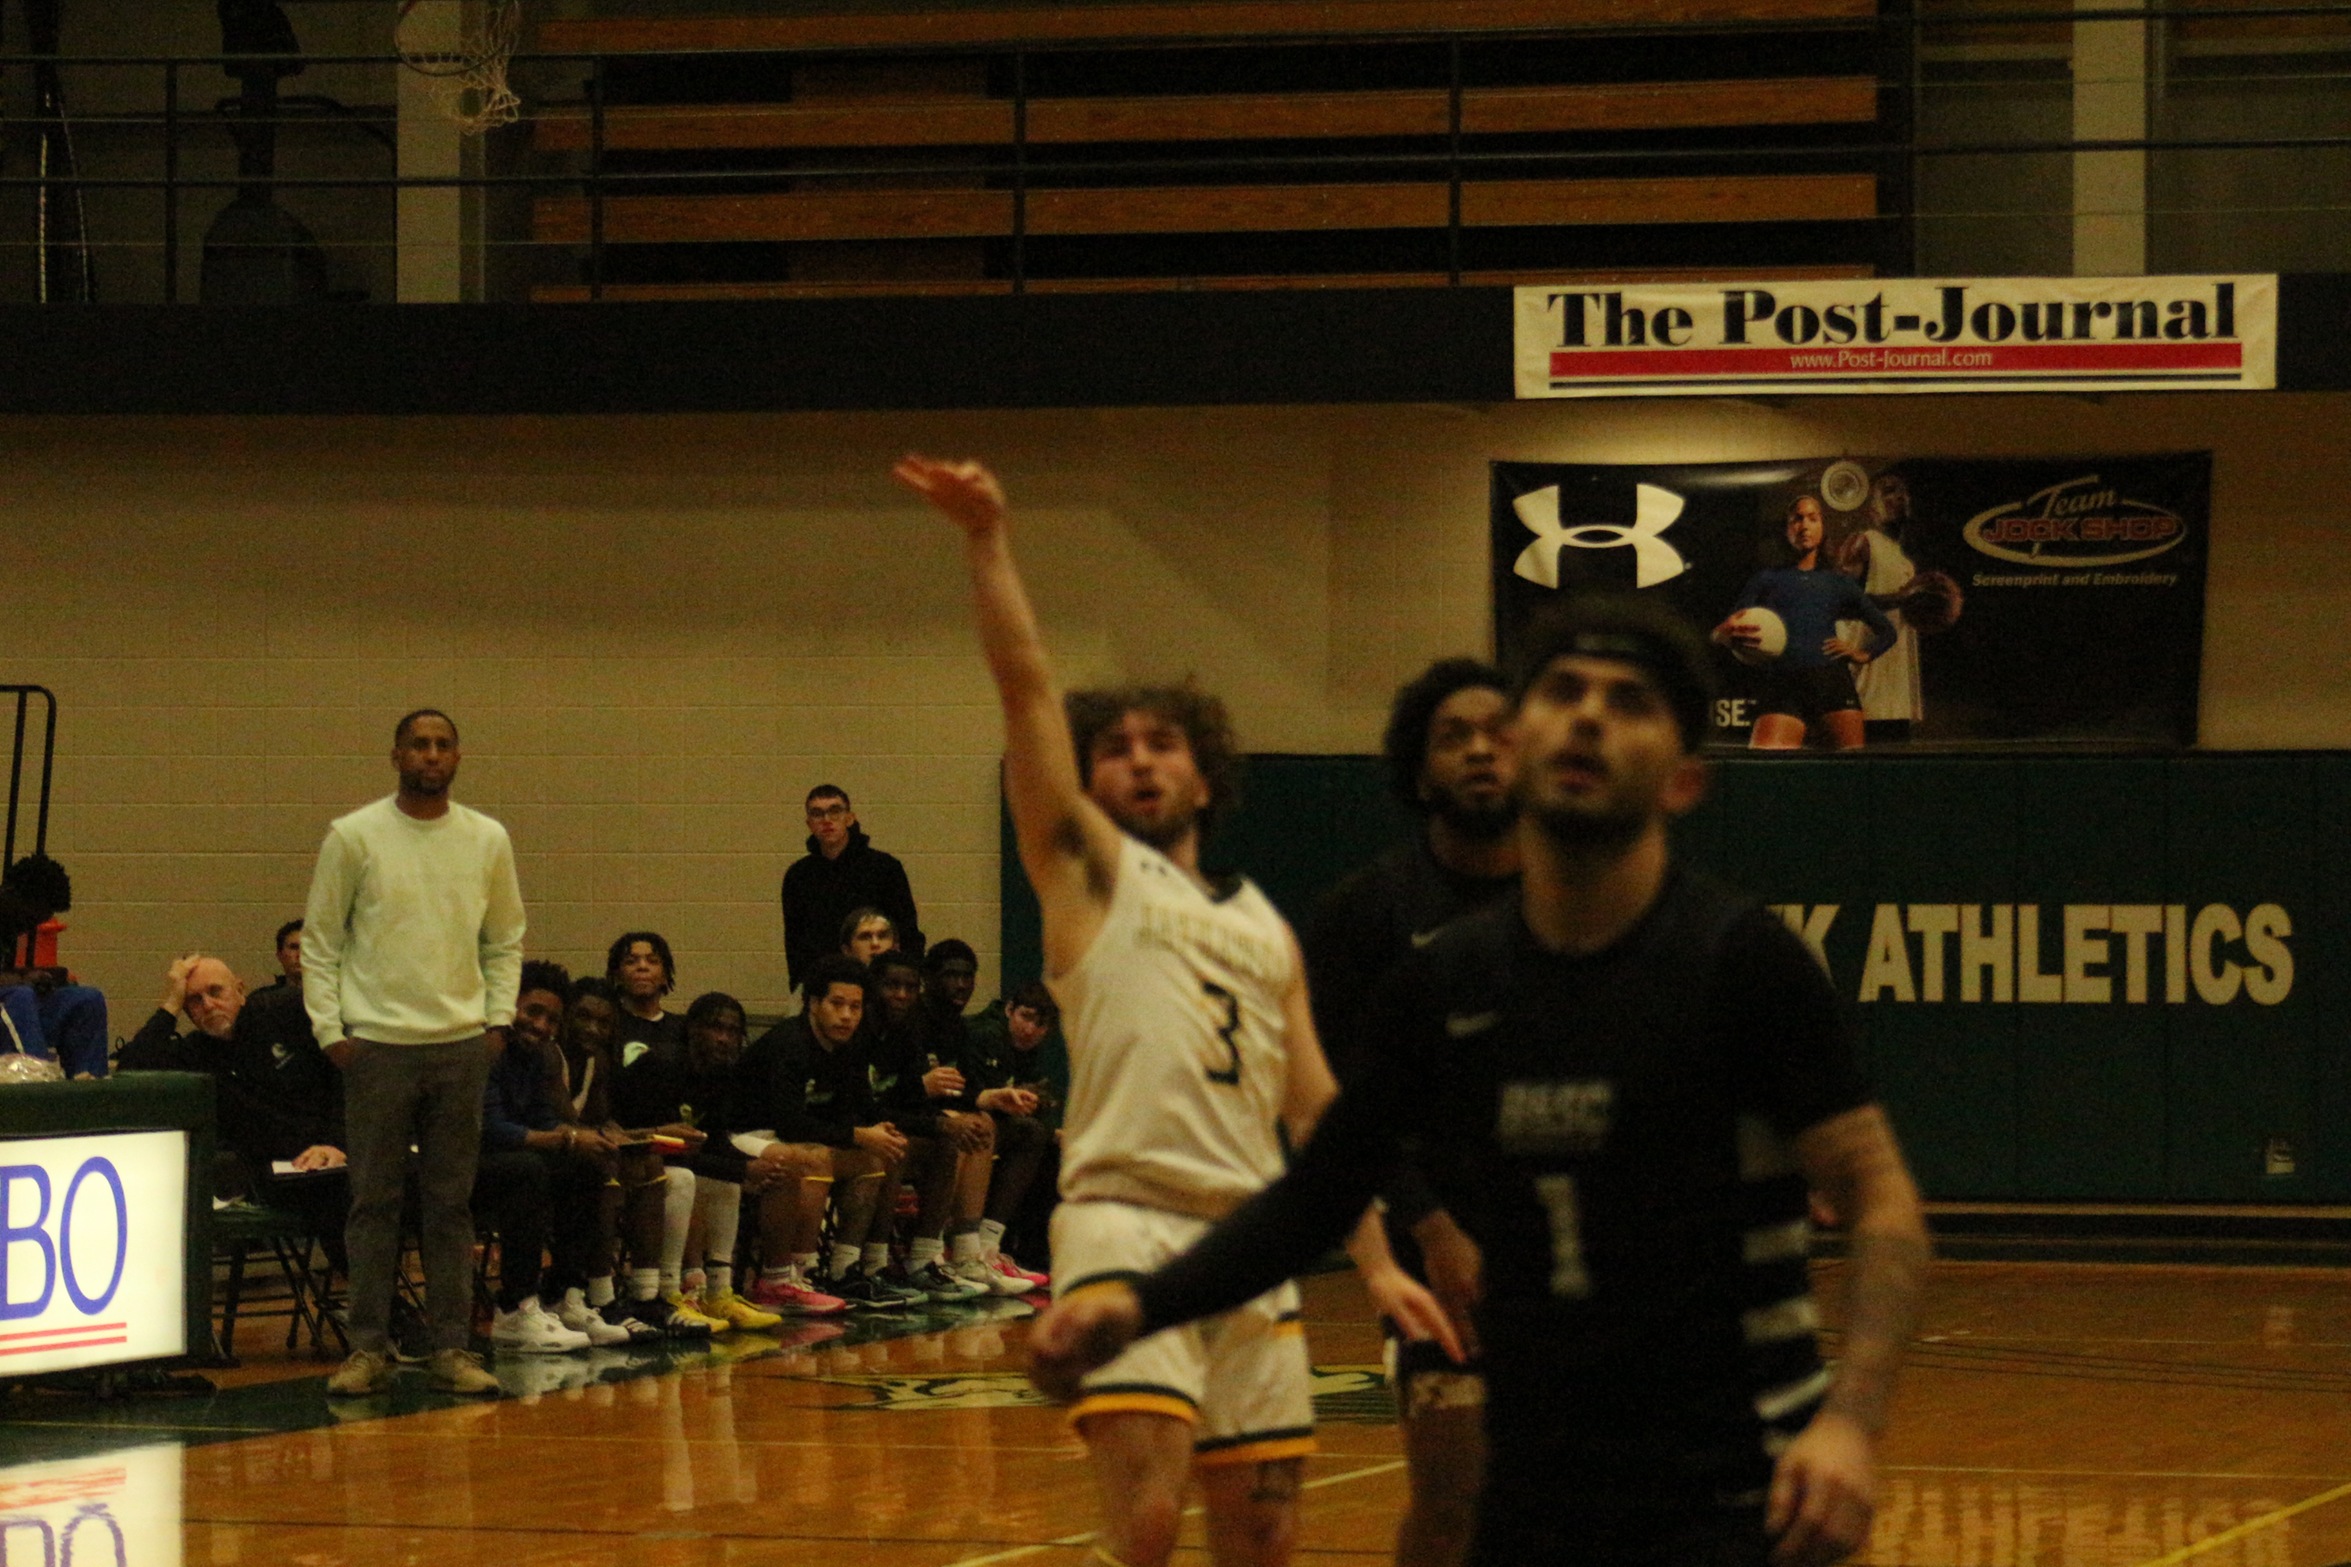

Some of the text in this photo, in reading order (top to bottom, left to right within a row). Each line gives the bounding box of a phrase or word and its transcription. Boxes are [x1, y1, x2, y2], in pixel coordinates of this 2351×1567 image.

[1547, 281, 2240, 347] The Post-Journal
[1790, 346, 1993, 370] www.Post-Journal.com
[1981, 516, 2178, 543] JOCK SHOP
[2027, 474, 2117, 519] Team
[1972, 572, 2178, 587] Screenprint and Embroidery
[1763, 903, 2295, 1006] K ATHLETICS
[1202, 980, 1241, 1086] 3
[0, 1156, 128, 1317] BO
[1535, 1174, 1590, 1297] 1
